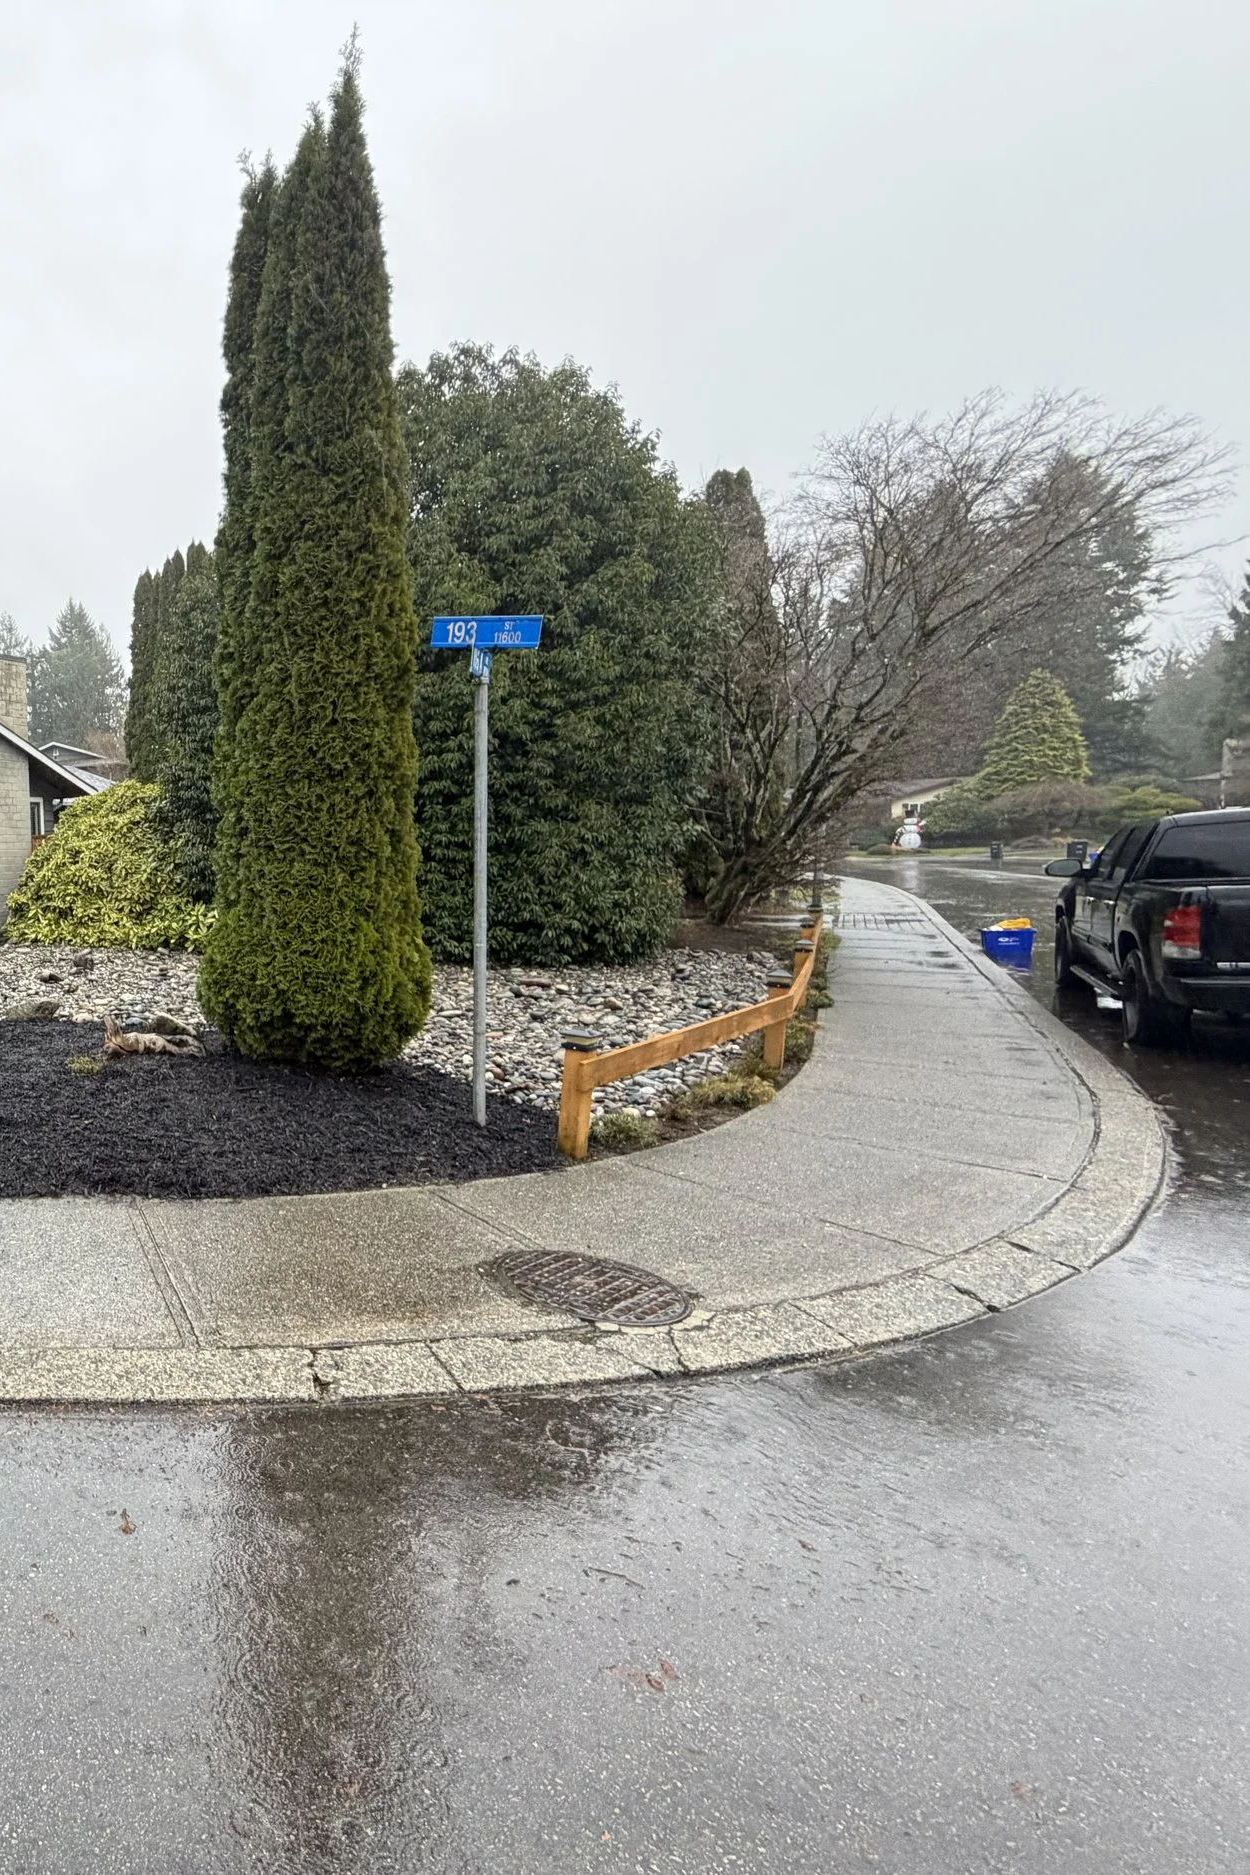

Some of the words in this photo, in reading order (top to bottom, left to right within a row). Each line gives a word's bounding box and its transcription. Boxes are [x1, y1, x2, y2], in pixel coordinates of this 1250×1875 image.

[504, 621, 515, 630] ST
[447, 621, 477, 643] 193
[494, 631, 521, 643] 11600
